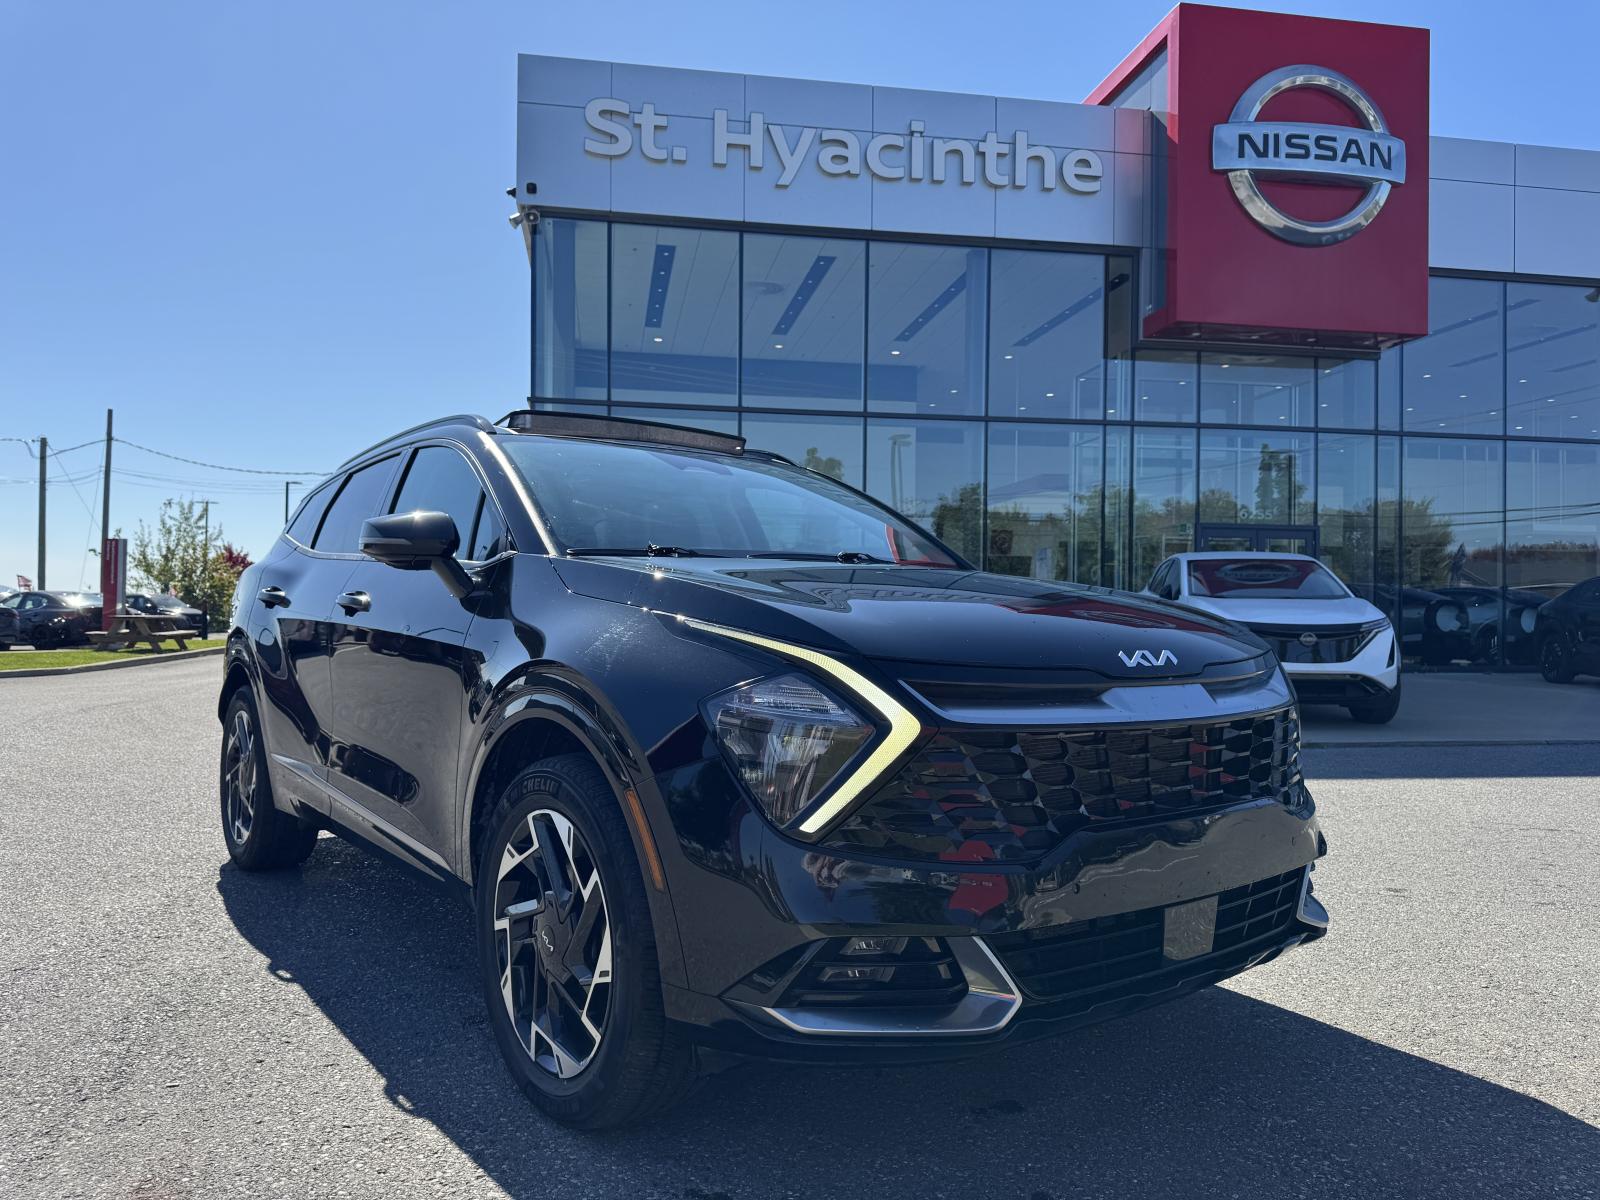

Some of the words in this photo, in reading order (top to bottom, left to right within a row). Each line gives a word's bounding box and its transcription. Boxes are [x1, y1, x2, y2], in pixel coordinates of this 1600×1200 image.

[583, 97, 688, 163] St.
[712, 107, 1104, 194] Hyacinthe
[1237, 132, 1393, 171] NISSAN
[1118, 649, 1178, 668] KIA
